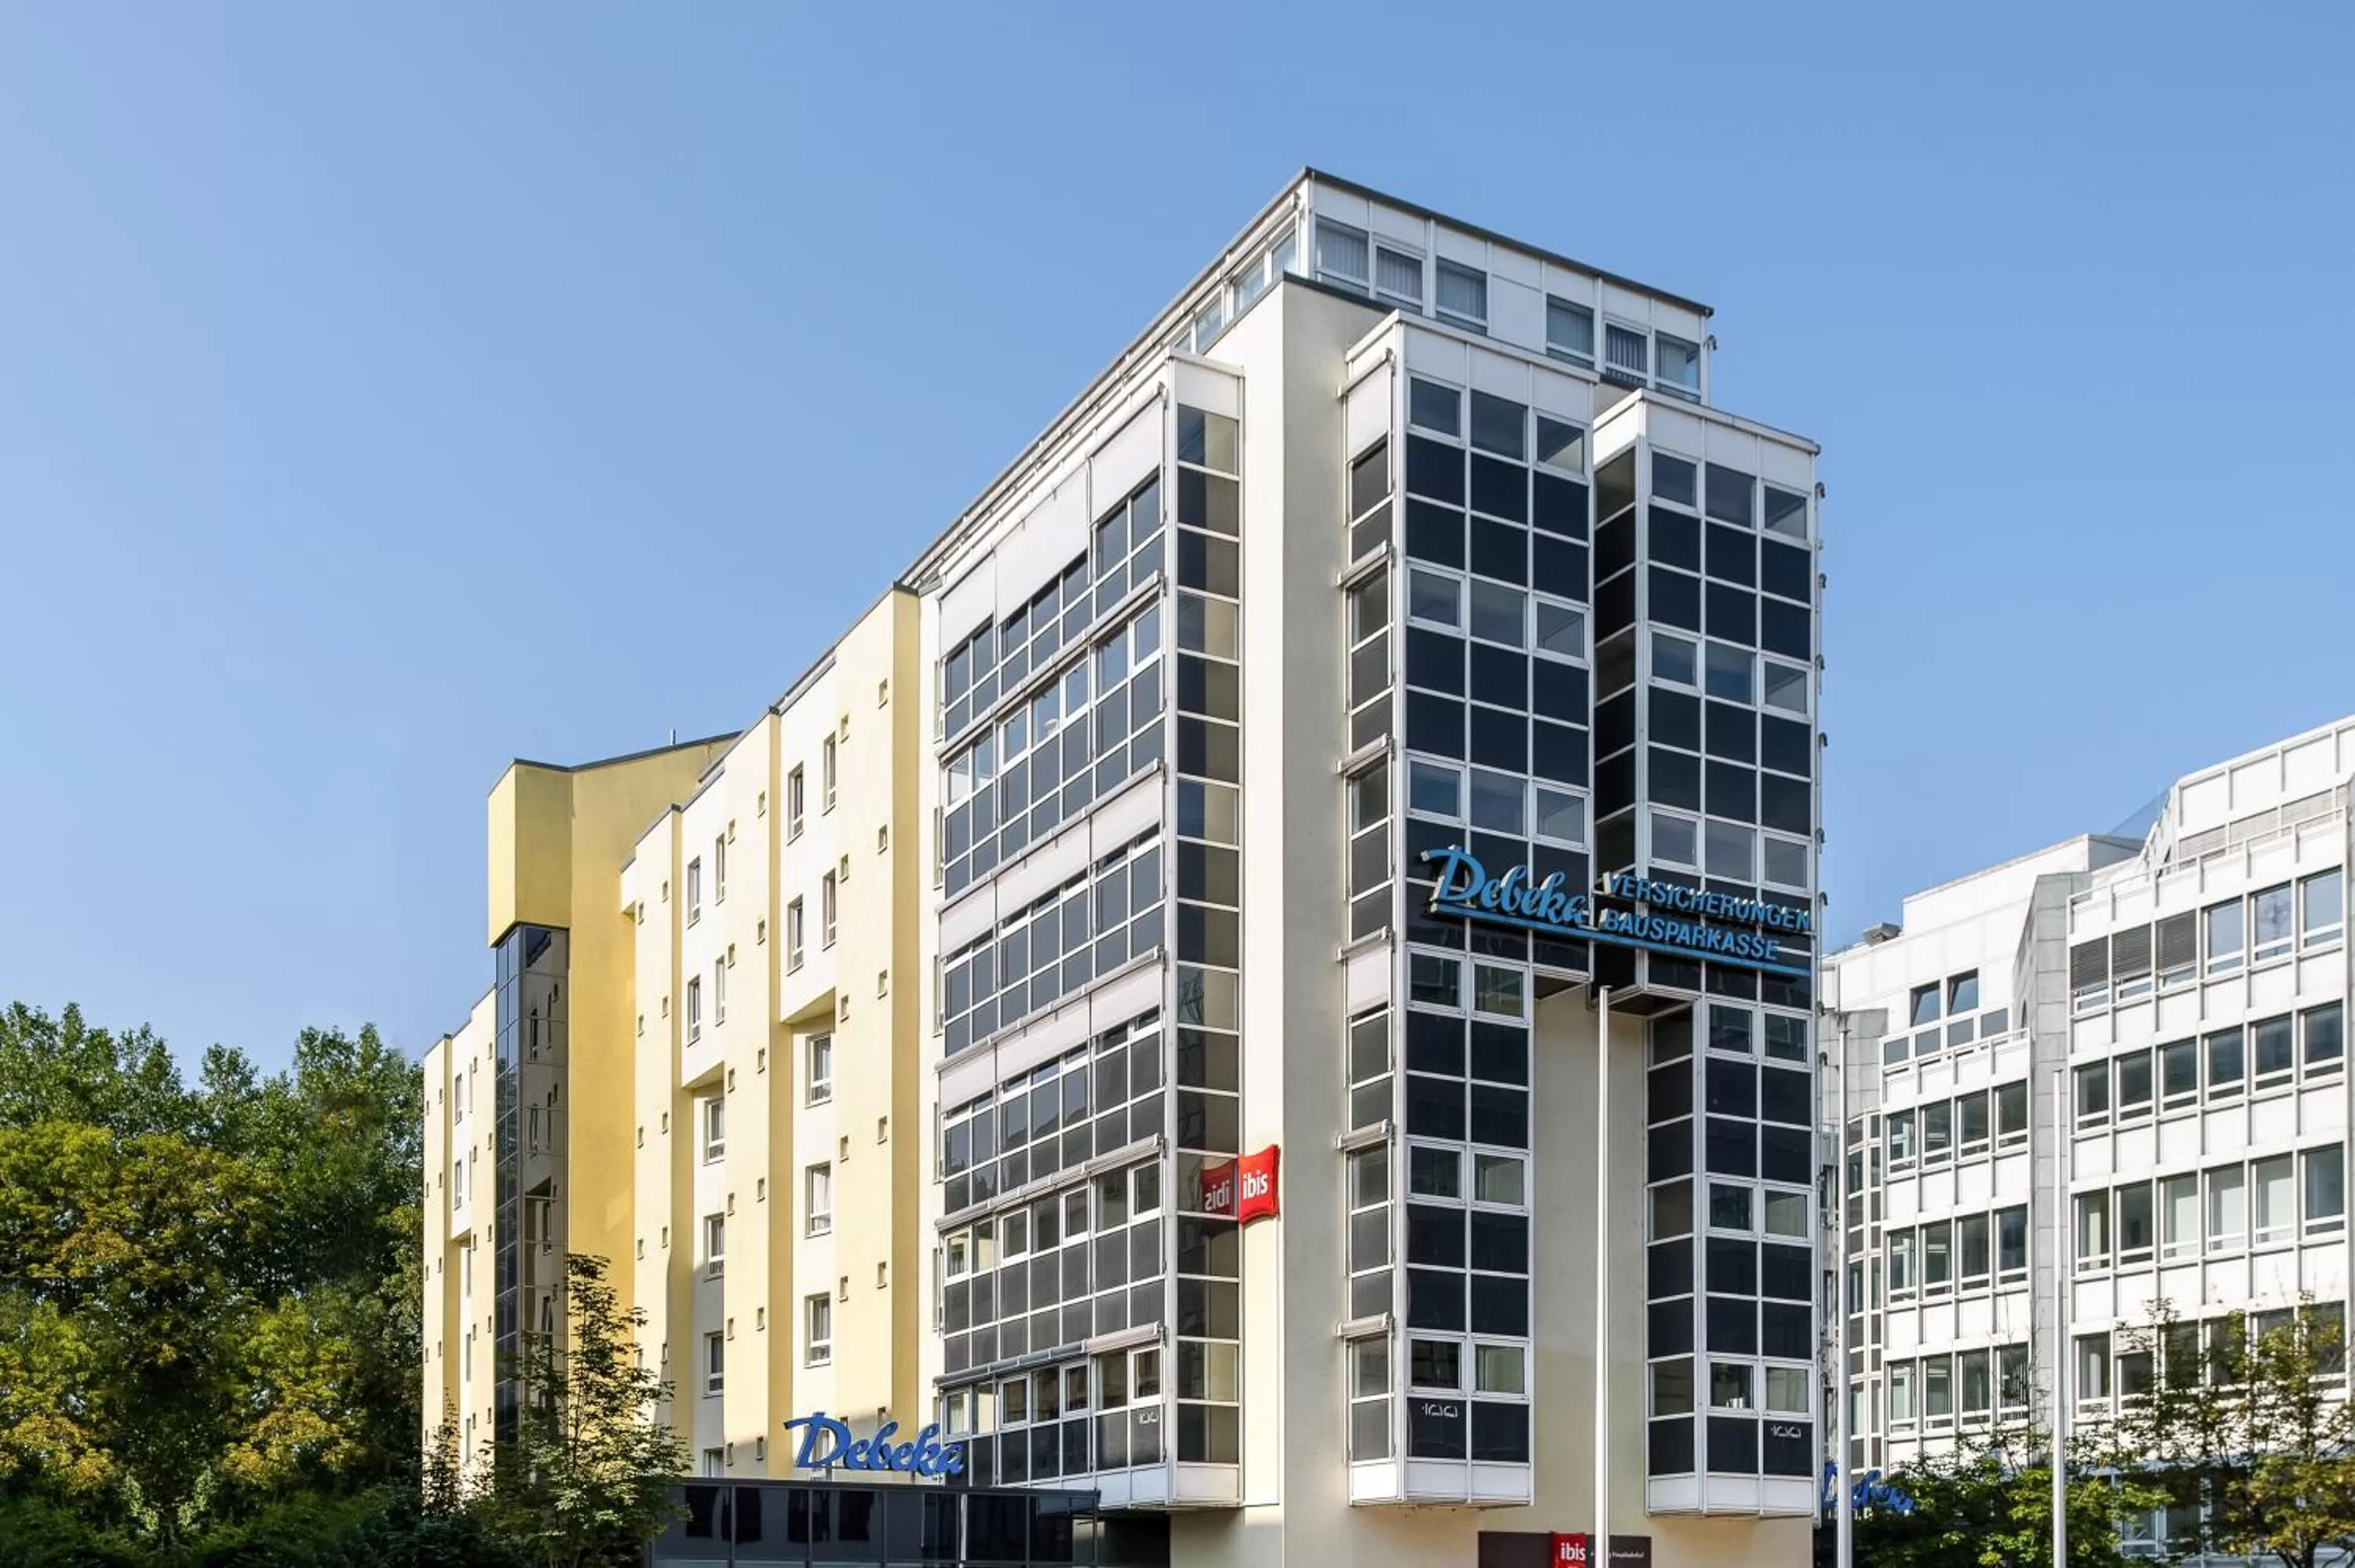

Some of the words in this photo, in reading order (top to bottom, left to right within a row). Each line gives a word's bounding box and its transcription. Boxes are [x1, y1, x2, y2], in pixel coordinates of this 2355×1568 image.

[1420, 844, 1589, 924] Debeka
[1607, 873, 1810, 930] VERSICHERUNGEN
[1602, 909, 1780, 961] BAUSPARKASSE
[1243, 1169, 1269, 1200] ibis
[783, 1412, 966, 1477] Debeka
[1561, 1542, 1586, 1561] ibis
